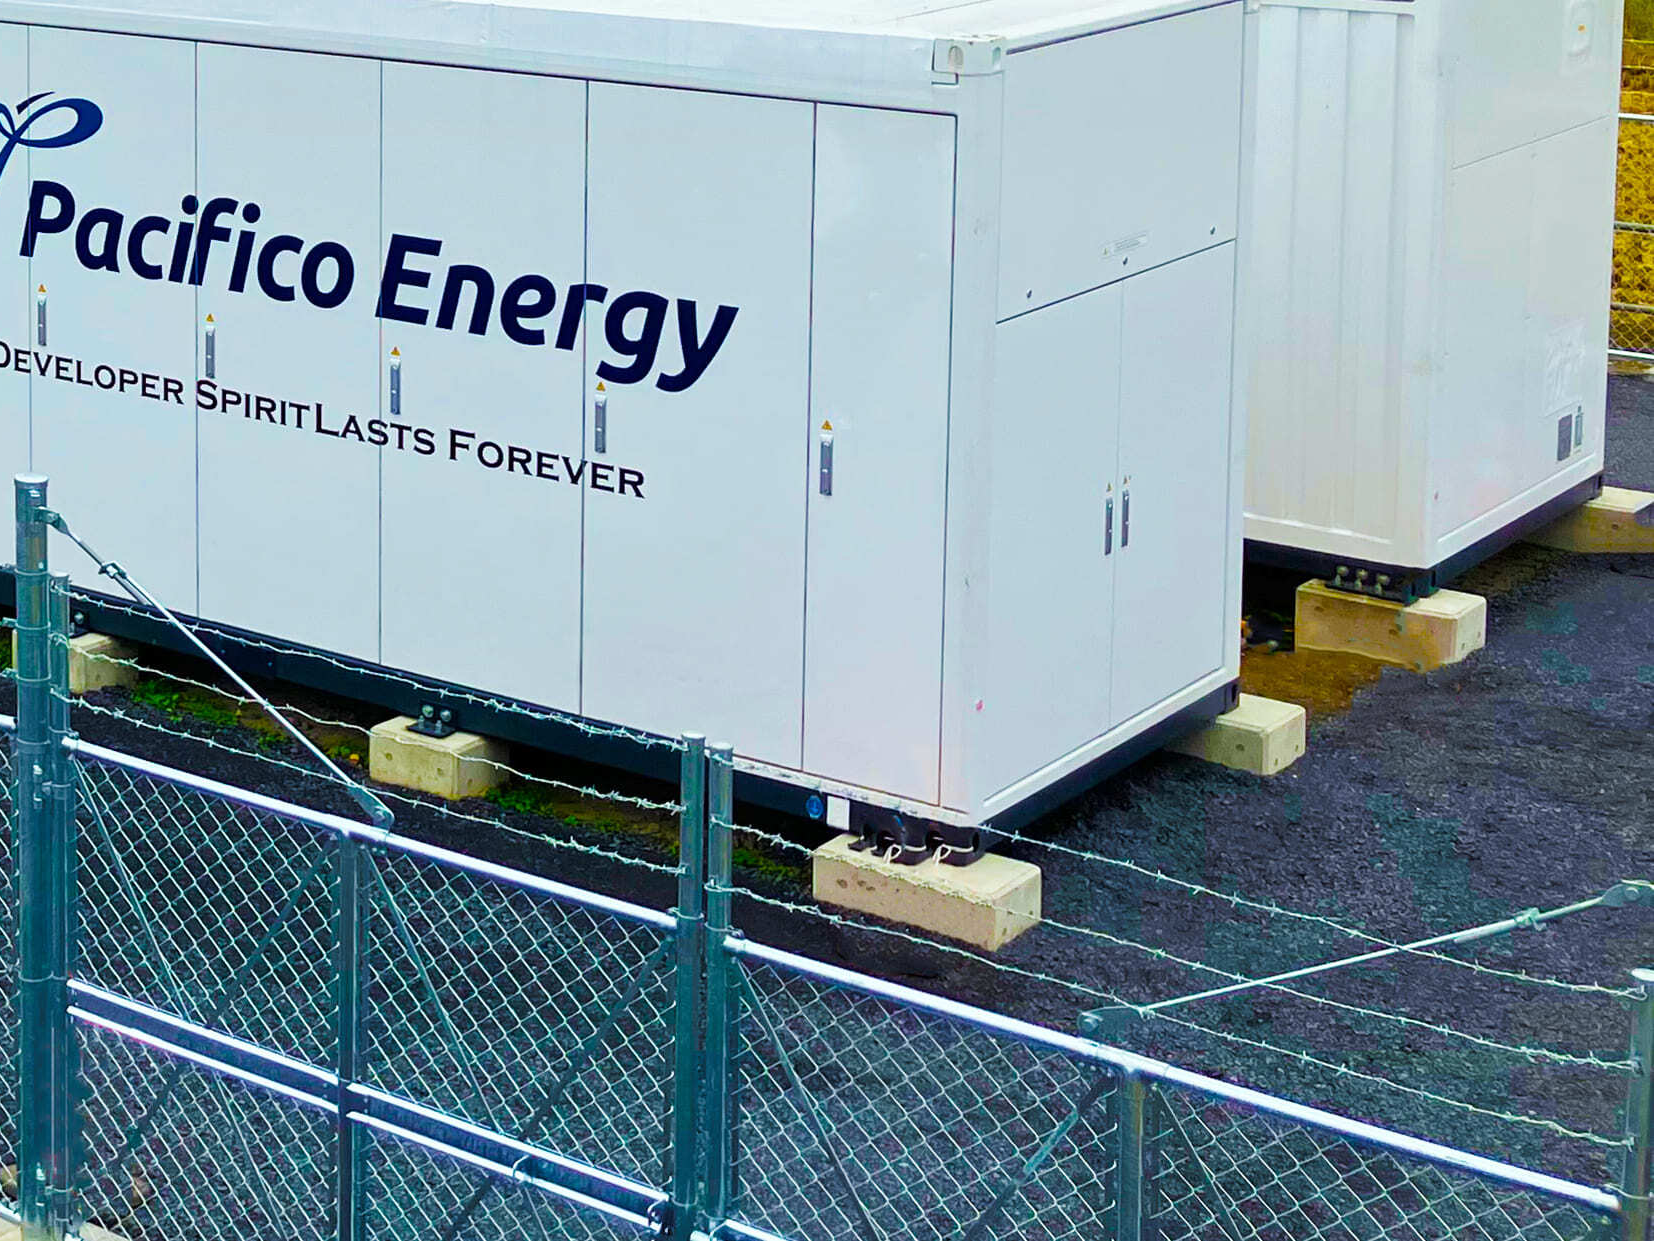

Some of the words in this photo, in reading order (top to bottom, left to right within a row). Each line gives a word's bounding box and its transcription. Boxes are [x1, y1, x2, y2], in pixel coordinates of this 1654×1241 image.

[19, 180, 355, 309] Pacifico
[374, 233, 740, 393] Energy
[449, 428, 645, 499] FOREVER
